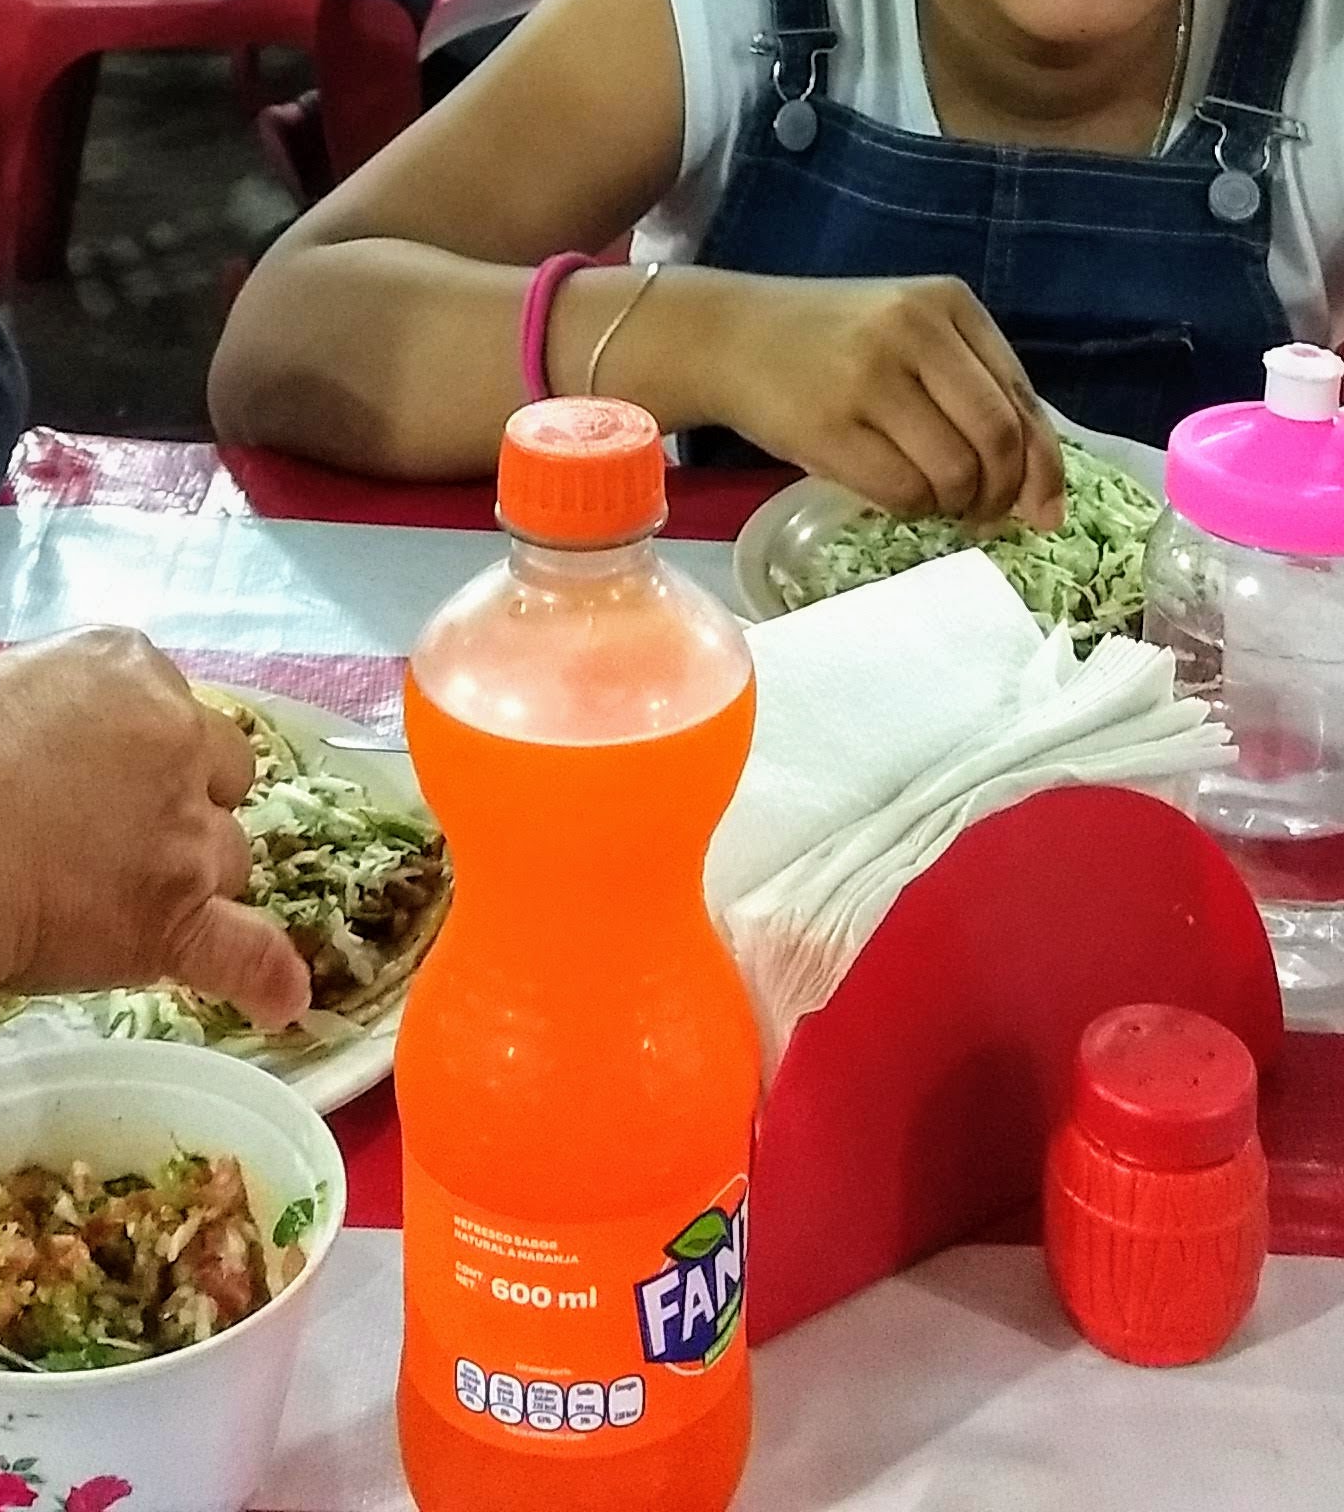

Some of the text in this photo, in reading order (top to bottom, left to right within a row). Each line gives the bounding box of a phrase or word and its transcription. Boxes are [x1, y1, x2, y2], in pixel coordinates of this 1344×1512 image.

[454, 1215, 513, 1245] REFRESCO
[454, 1228, 506, 1255] NATURAL
[491, 1276, 598, 1309] 600 ml
[642, 1199, 749, 1357] FAN
